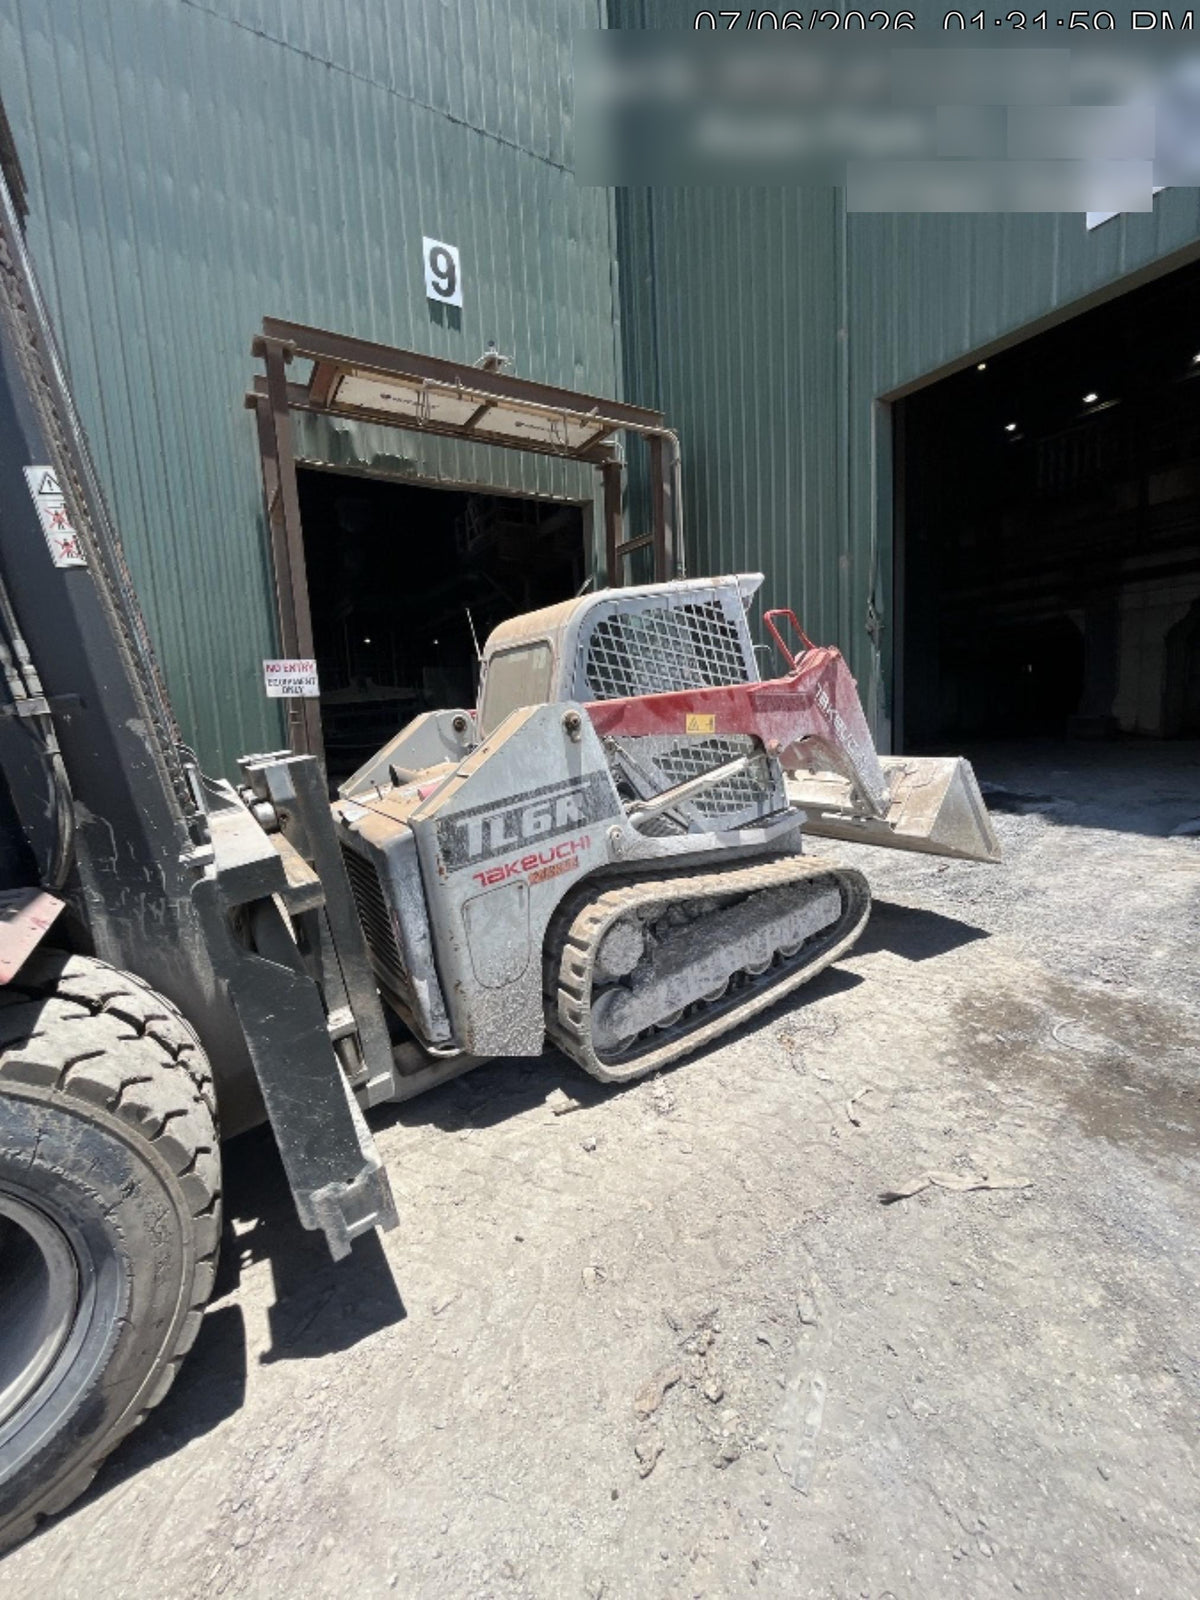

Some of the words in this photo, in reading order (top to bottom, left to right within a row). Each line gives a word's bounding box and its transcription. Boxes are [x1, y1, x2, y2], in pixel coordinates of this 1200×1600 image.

[429, 246, 456, 298] 9
[266, 664, 281, 672] NO
[284, 663, 313, 672] ENTRY
[457, 782, 590, 857] TL6R
